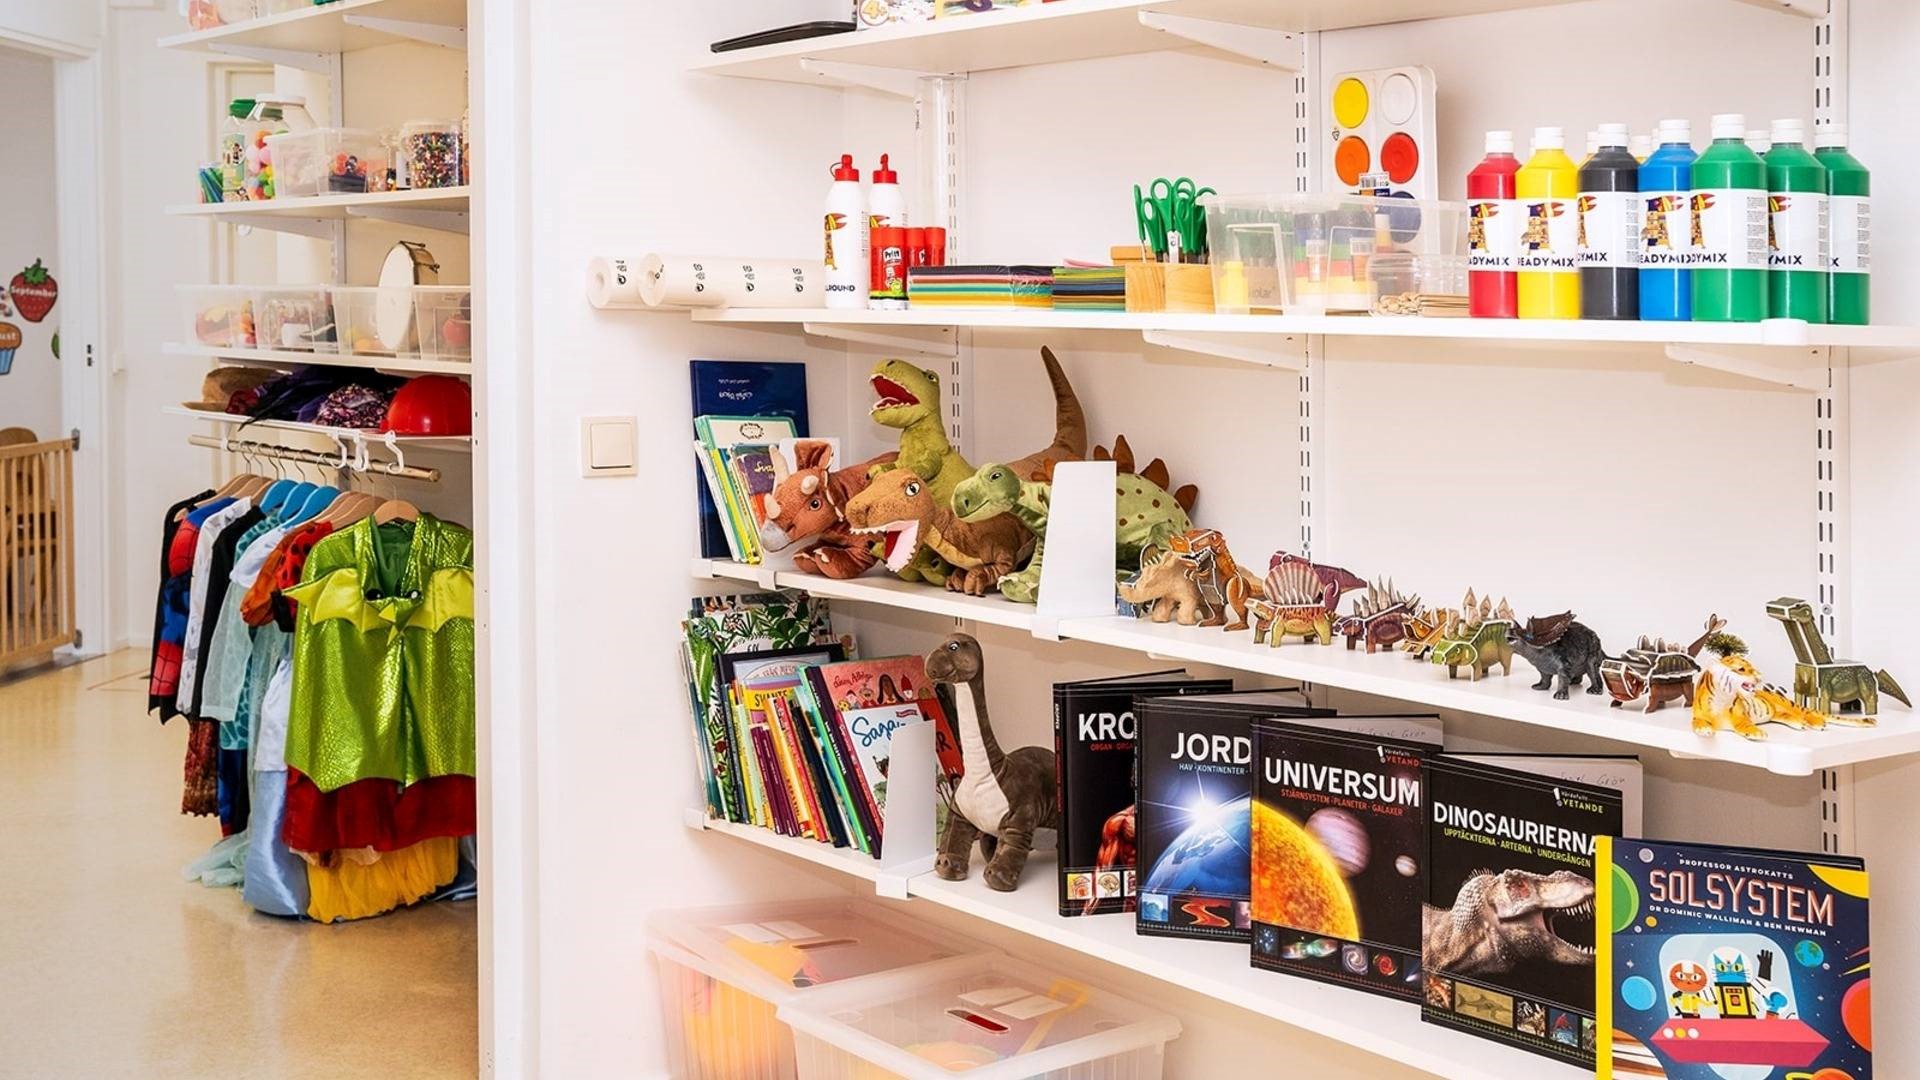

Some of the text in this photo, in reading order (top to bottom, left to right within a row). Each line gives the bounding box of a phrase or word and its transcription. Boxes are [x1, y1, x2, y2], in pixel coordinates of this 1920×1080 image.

[1517, 256, 1574, 267] EADYMIX
[1178, 763, 1245, 775] HAV KONTINENTER
[1385, 755, 1421, 767] VETAND
[1265, 757, 1420, 807] UNIVERSUM
[1281, 789, 1403, 816] STJÄRNSYSTEM PLANETER GALAXER
[1563, 798, 1603, 814] VETANDE
[1433, 801, 1596, 856] DINOSAURIERNA
[1444, 827, 1591, 868] UPPTÄCKTERNA ARTERNA UNDERGÅNGEN
[1679, 859, 1793, 880] PROFESSOR ASTROKATTS
[1649, 869, 1835, 927] SOLSYSTEM
[1664, 907, 1702, 918] DOMINIC
[1705, 912, 1752, 926] WALLIMAN
[1764, 921, 1782, 930] BEN
[1785, 924, 1827, 937] NEWMAN
